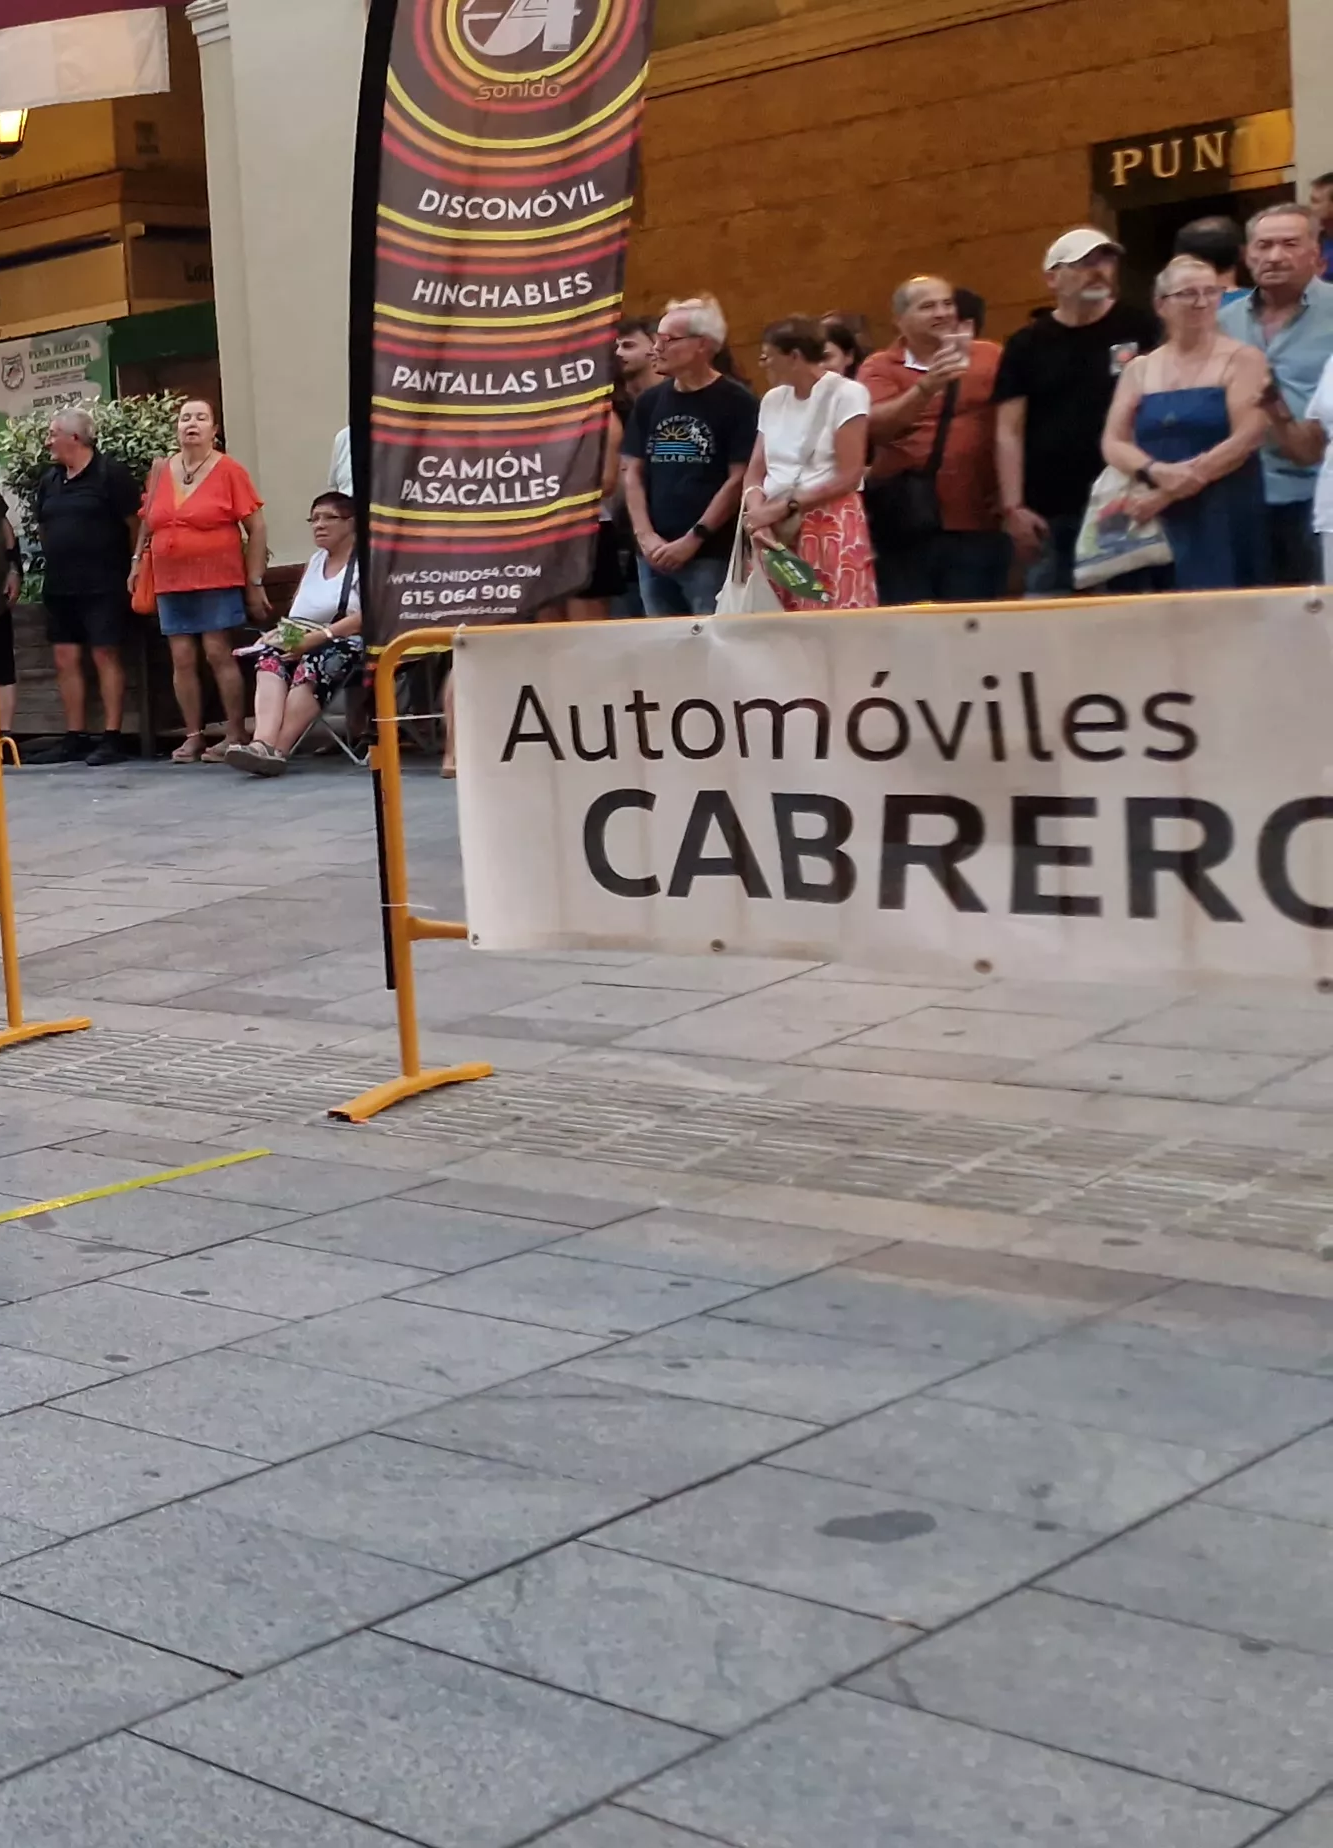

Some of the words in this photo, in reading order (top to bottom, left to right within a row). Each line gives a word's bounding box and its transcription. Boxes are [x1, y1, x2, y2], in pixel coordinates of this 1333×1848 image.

[475, 77, 562, 101] sonido
[418, 180, 605, 221] DISCOMÓVIL
[412, 272, 593, 308] HINCHABLES
[392, 364, 538, 396] PANTALLAS
[544, 358, 596, 389] LED
[417, 449, 543, 481] CAMIÓN
[400, 475, 561, 506] PASACALLES
[400, 589, 436, 606] 615
[438, 586, 478, 604] 064
[481, 583, 523, 600] 906
[499, 671, 1198, 763] Automóviles
